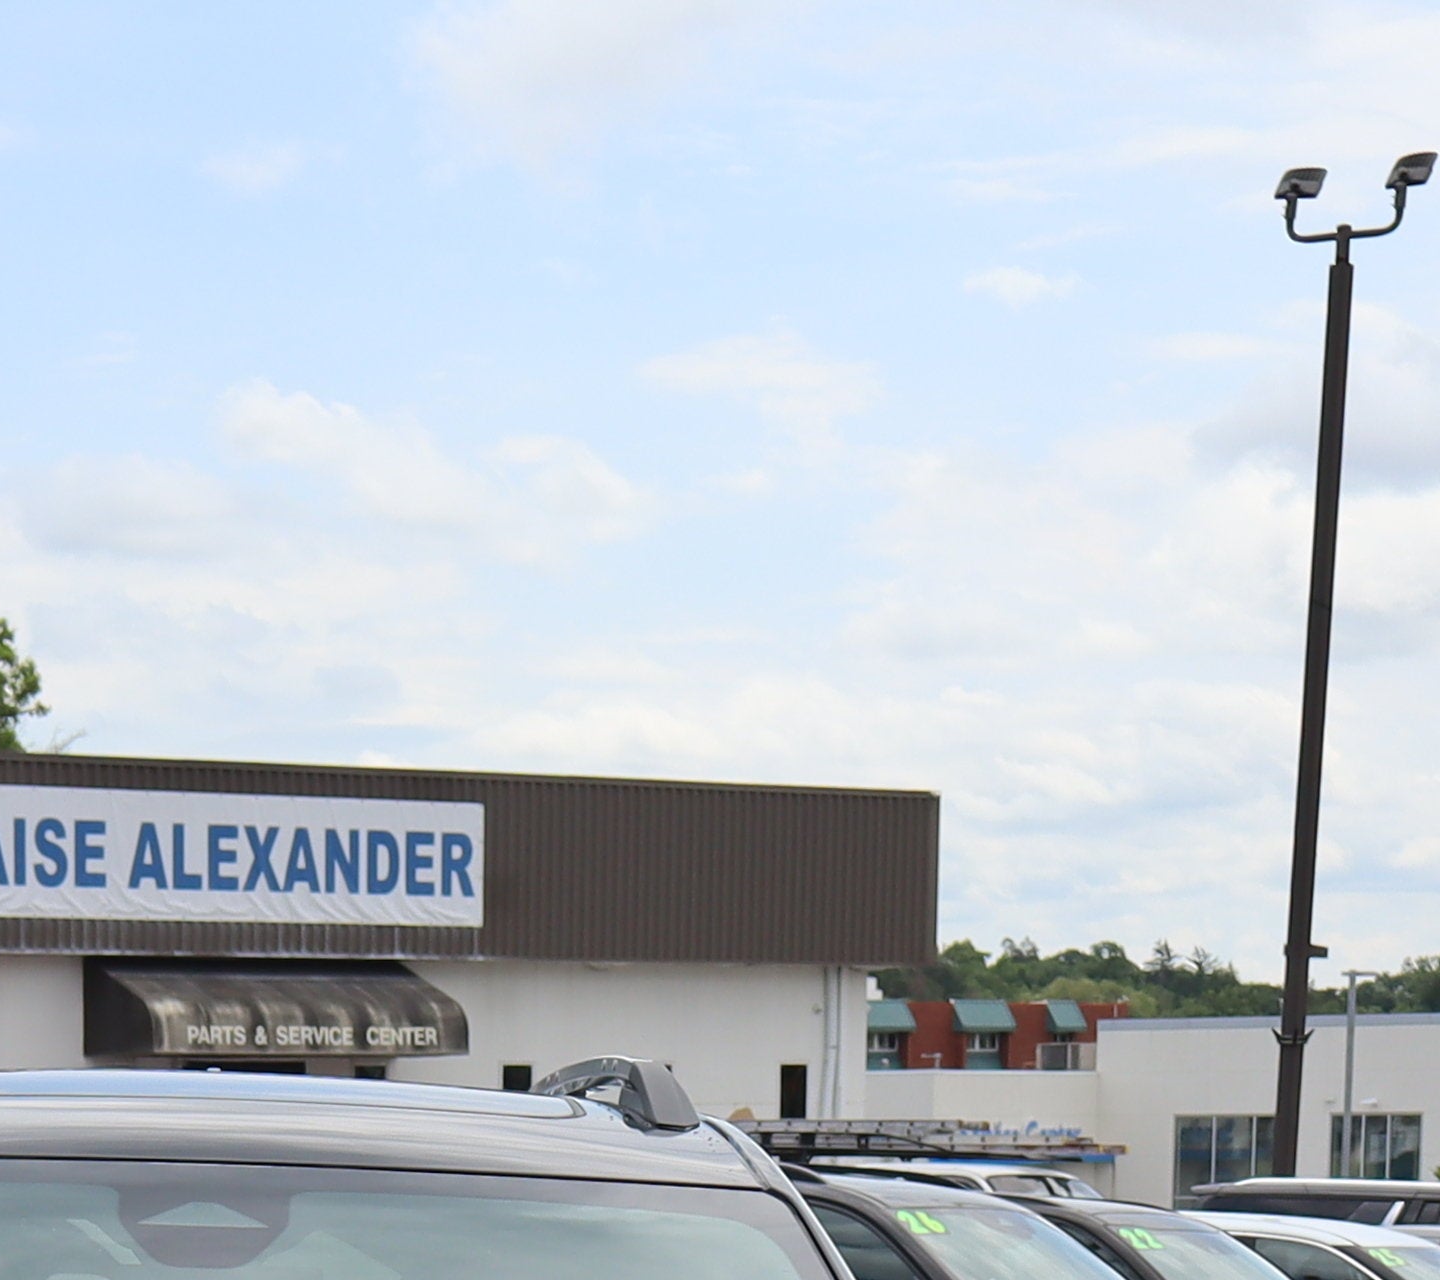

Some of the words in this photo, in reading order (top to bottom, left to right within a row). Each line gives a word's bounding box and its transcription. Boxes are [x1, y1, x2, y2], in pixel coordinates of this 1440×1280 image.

[128, 822, 474, 897] ALEXANDER
[187, 1025, 246, 1045] PARTS
[254, 1026, 267, 1045] &
[276, 1026, 354, 1046] SERVICE
[366, 1027, 438, 1046] CENTER
[896, 1209, 947, 1234] 26
[1118, 1227, 1165, 1250] 22
